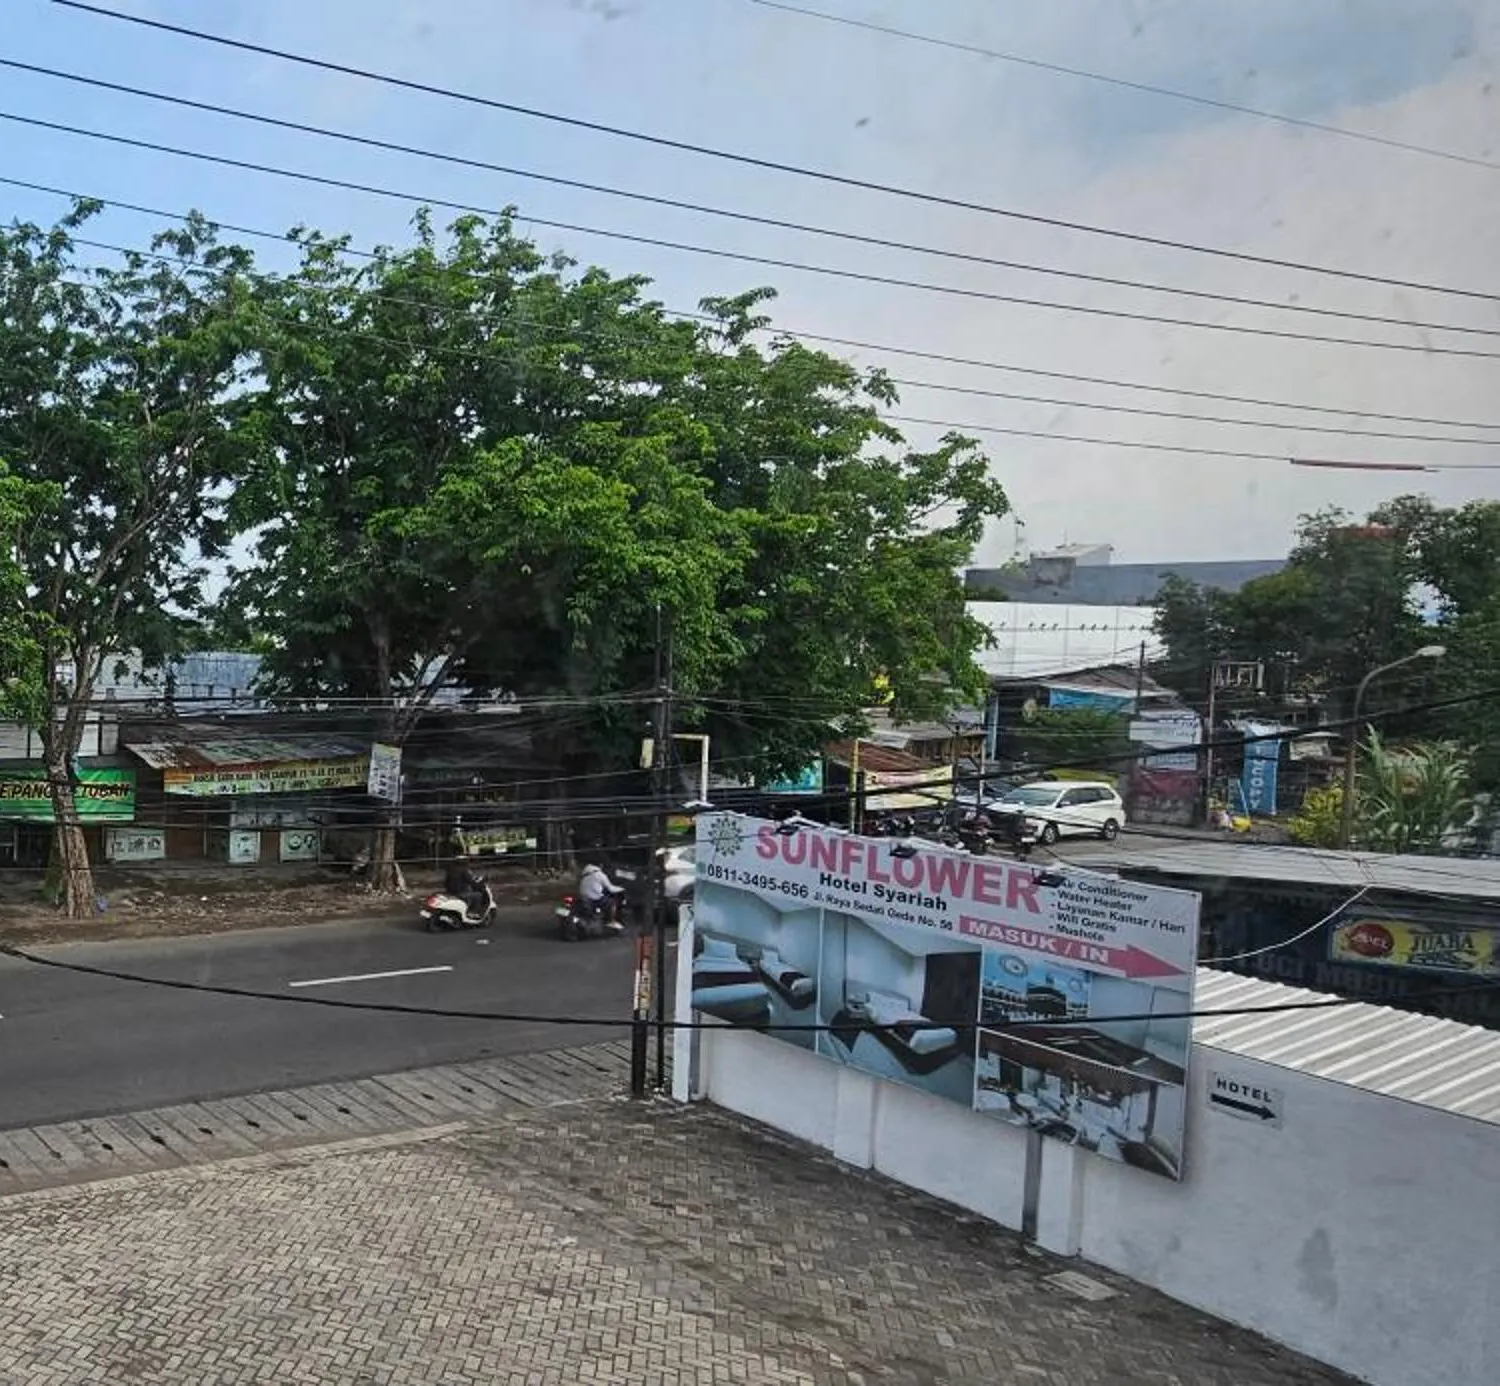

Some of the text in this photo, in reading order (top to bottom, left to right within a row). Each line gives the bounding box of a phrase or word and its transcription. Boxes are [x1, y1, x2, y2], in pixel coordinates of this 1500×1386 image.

[707, 863, 809, 898] 0811-3495-656
[756, 825, 1041, 914] SUNFLOWER
[820, 873, 947, 911] Hotel Syariah
[1058, 890, 1132, 911] Water Heater
[1078, 881, 1148, 901] Conditioner
[825, 893, 851, 908] Raya
[918, 914, 937, 928] No.
[1109, 911, 1150, 927] Kamar
[1159, 919, 1185, 934] Hari
[968, 920, 1055, 953] MASUK
[1080, 947, 1110, 966] IN
[1216, 1078, 1272, 1103] HOTEL
